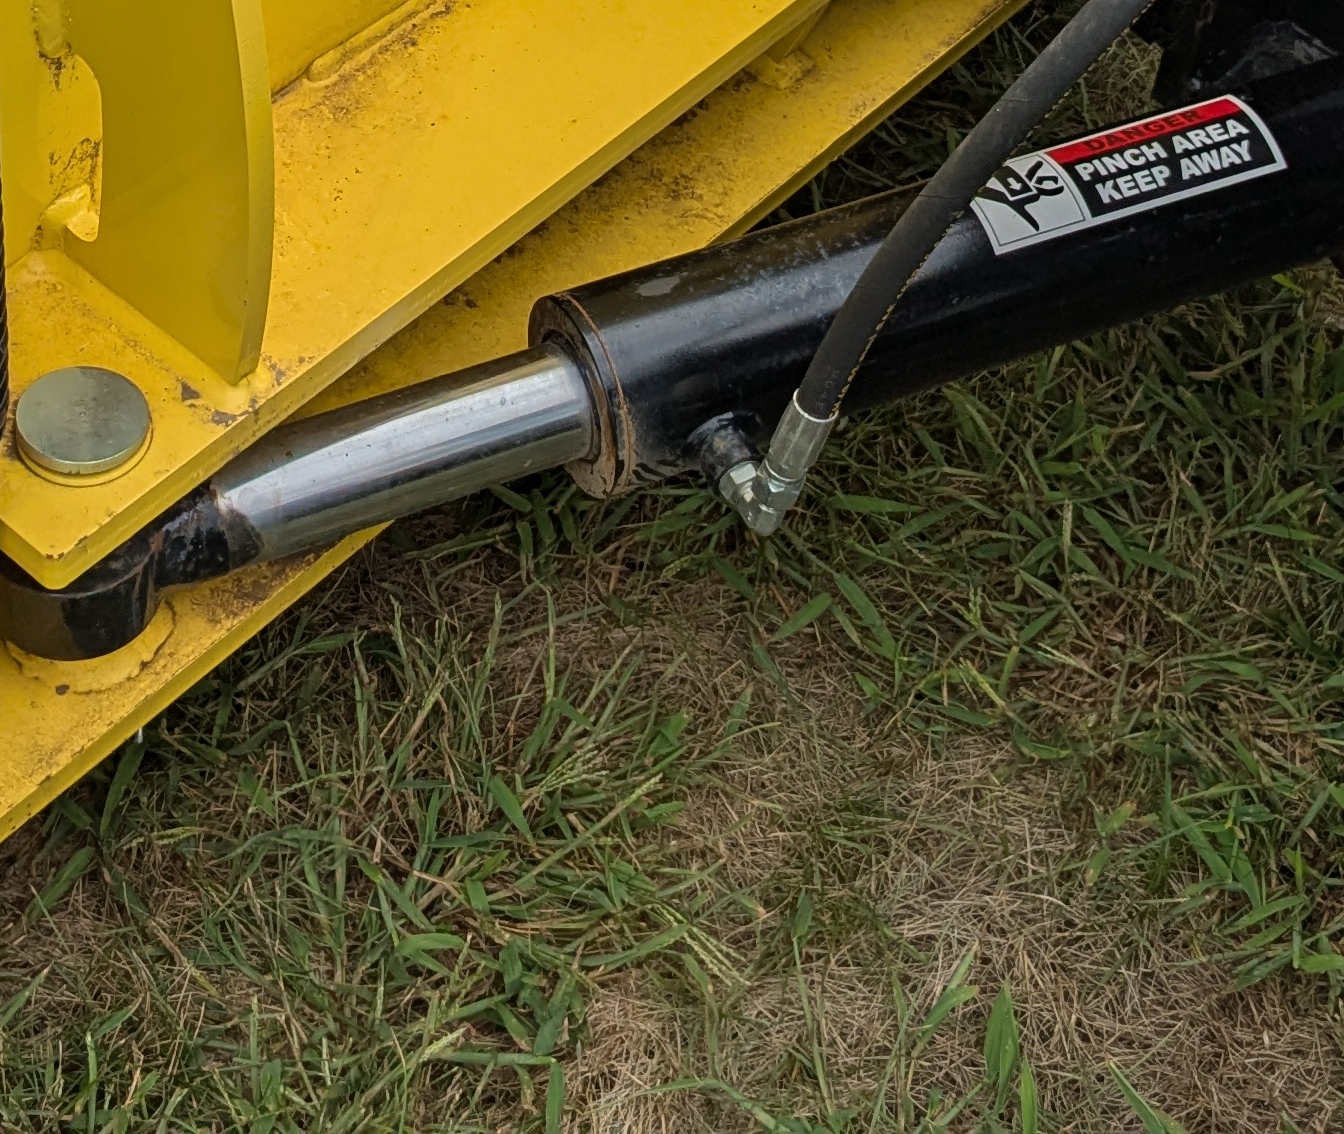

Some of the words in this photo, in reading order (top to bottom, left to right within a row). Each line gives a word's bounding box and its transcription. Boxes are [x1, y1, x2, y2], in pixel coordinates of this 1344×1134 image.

[1073, 141, 1168, 182] PINCH
[1172, 118, 1250, 155] AREA
[1085, 110, 1201, 151] DANGER
[1094, 165, 1172, 204] KEEP
[1181, 140, 1255, 182] AWAY
